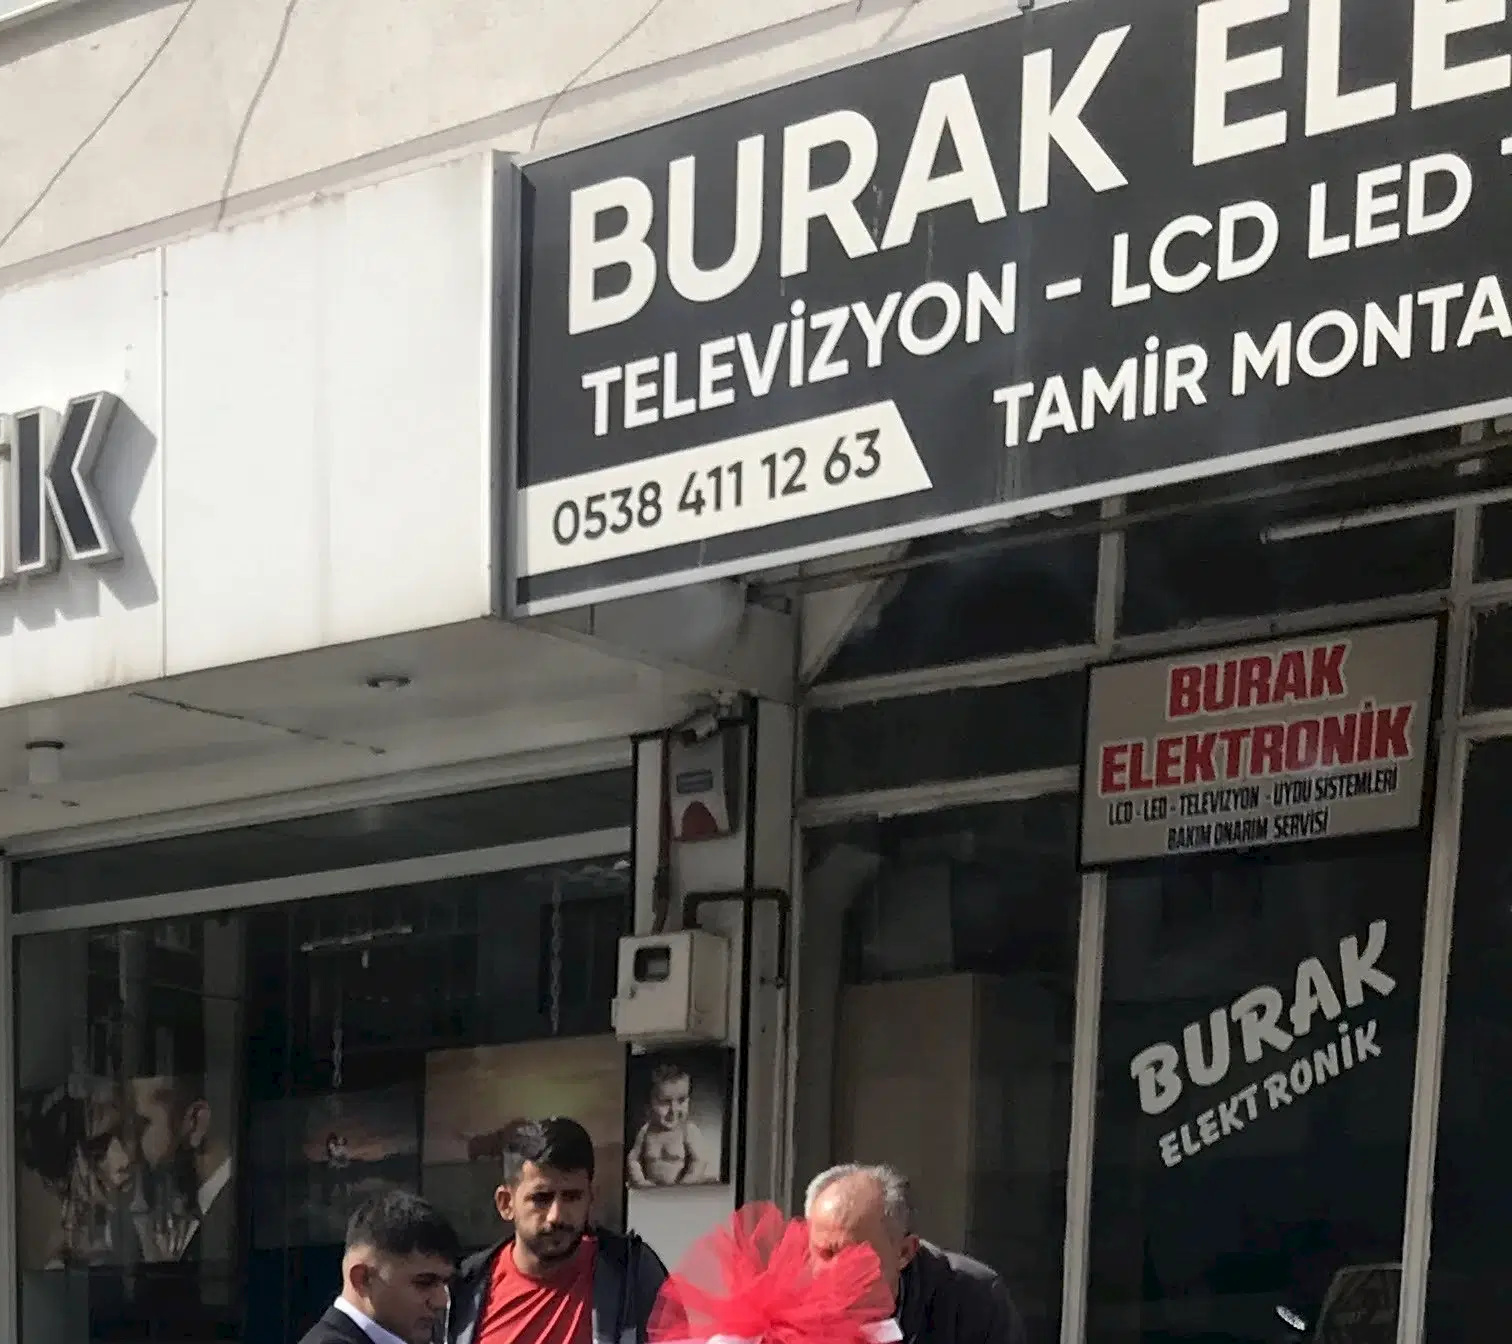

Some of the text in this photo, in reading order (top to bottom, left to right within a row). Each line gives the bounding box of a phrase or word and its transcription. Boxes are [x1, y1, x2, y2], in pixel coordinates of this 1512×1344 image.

[568, 24, 1131, 335] BURAK
[581, 261, 1017, 437] TELEVİZYON
[1112, 199, 1279, 307] LCD
[1308, 153, 1473, 260] LED
[993, 335, 1209, 448] TAMİR
[552, 428, 882, 545] 0538 411 12 63
[1100, 700, 1413, 794] ELEKTRONİK
[1169, 644, 1347, 717] BURAK
[1131, 919, 1396, 1116] BURAK
[1158, 1019, 1383, 1169] ELEKTRONİK
